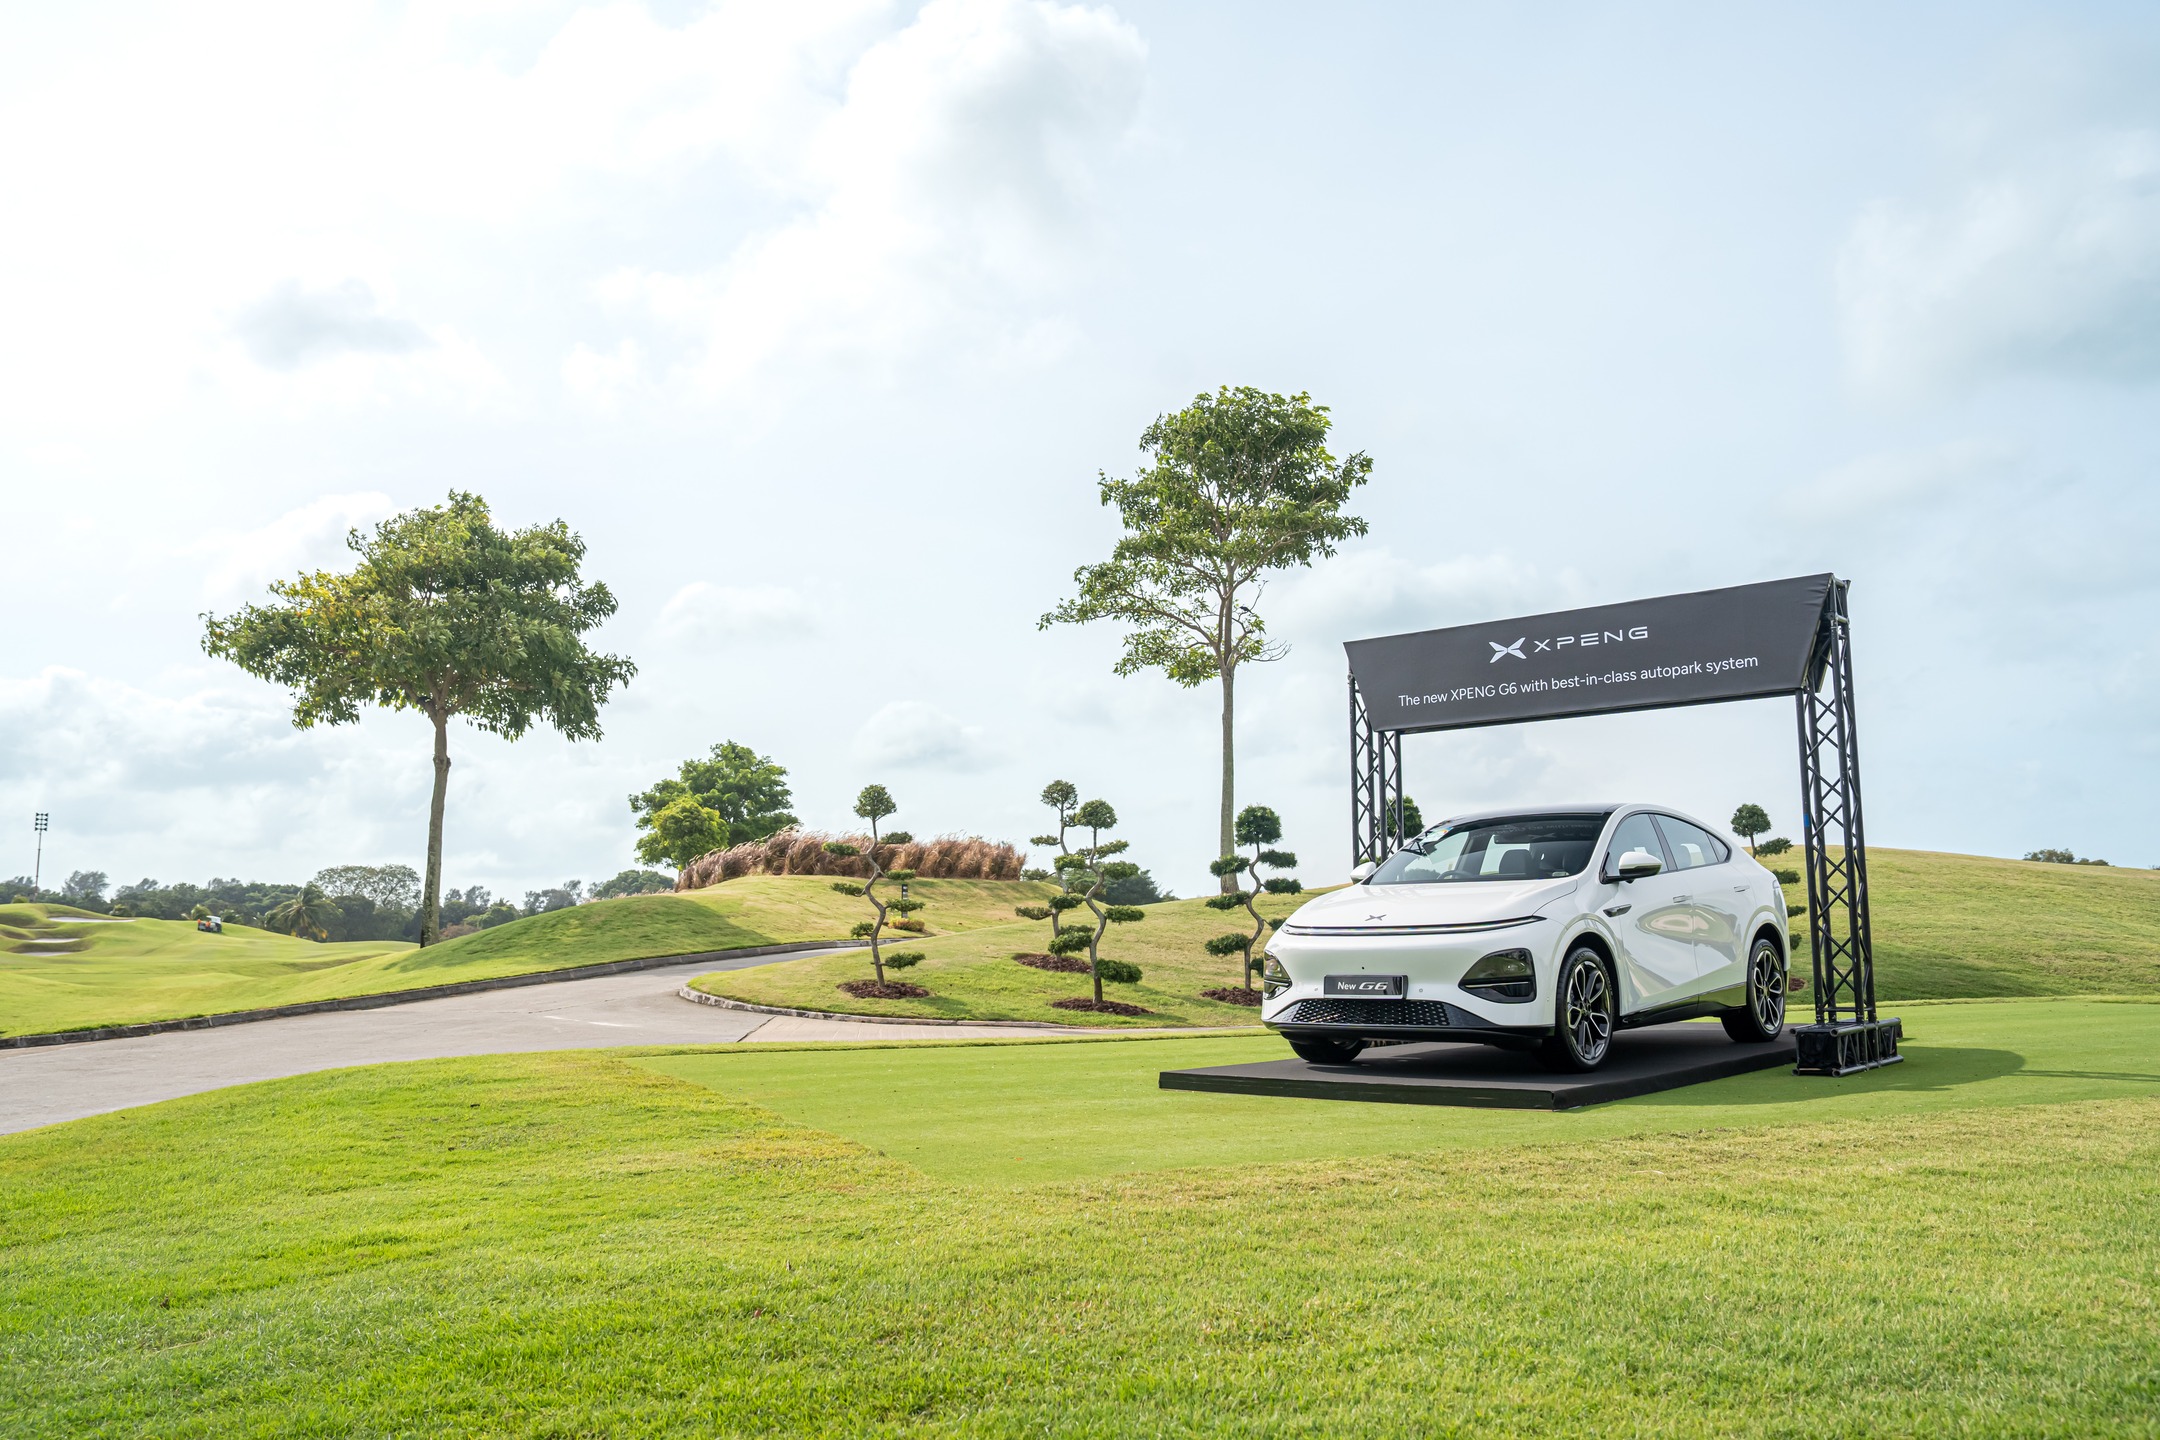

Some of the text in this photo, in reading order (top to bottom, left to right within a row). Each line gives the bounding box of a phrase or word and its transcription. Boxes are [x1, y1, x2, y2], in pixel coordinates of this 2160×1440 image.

[1533, 625, 1649, 653] XPENG
[1397, 656, 1759, 707] The new XPENG G6 with best-in-class autopark system
[1337, 981, 1389, 991] New G6
